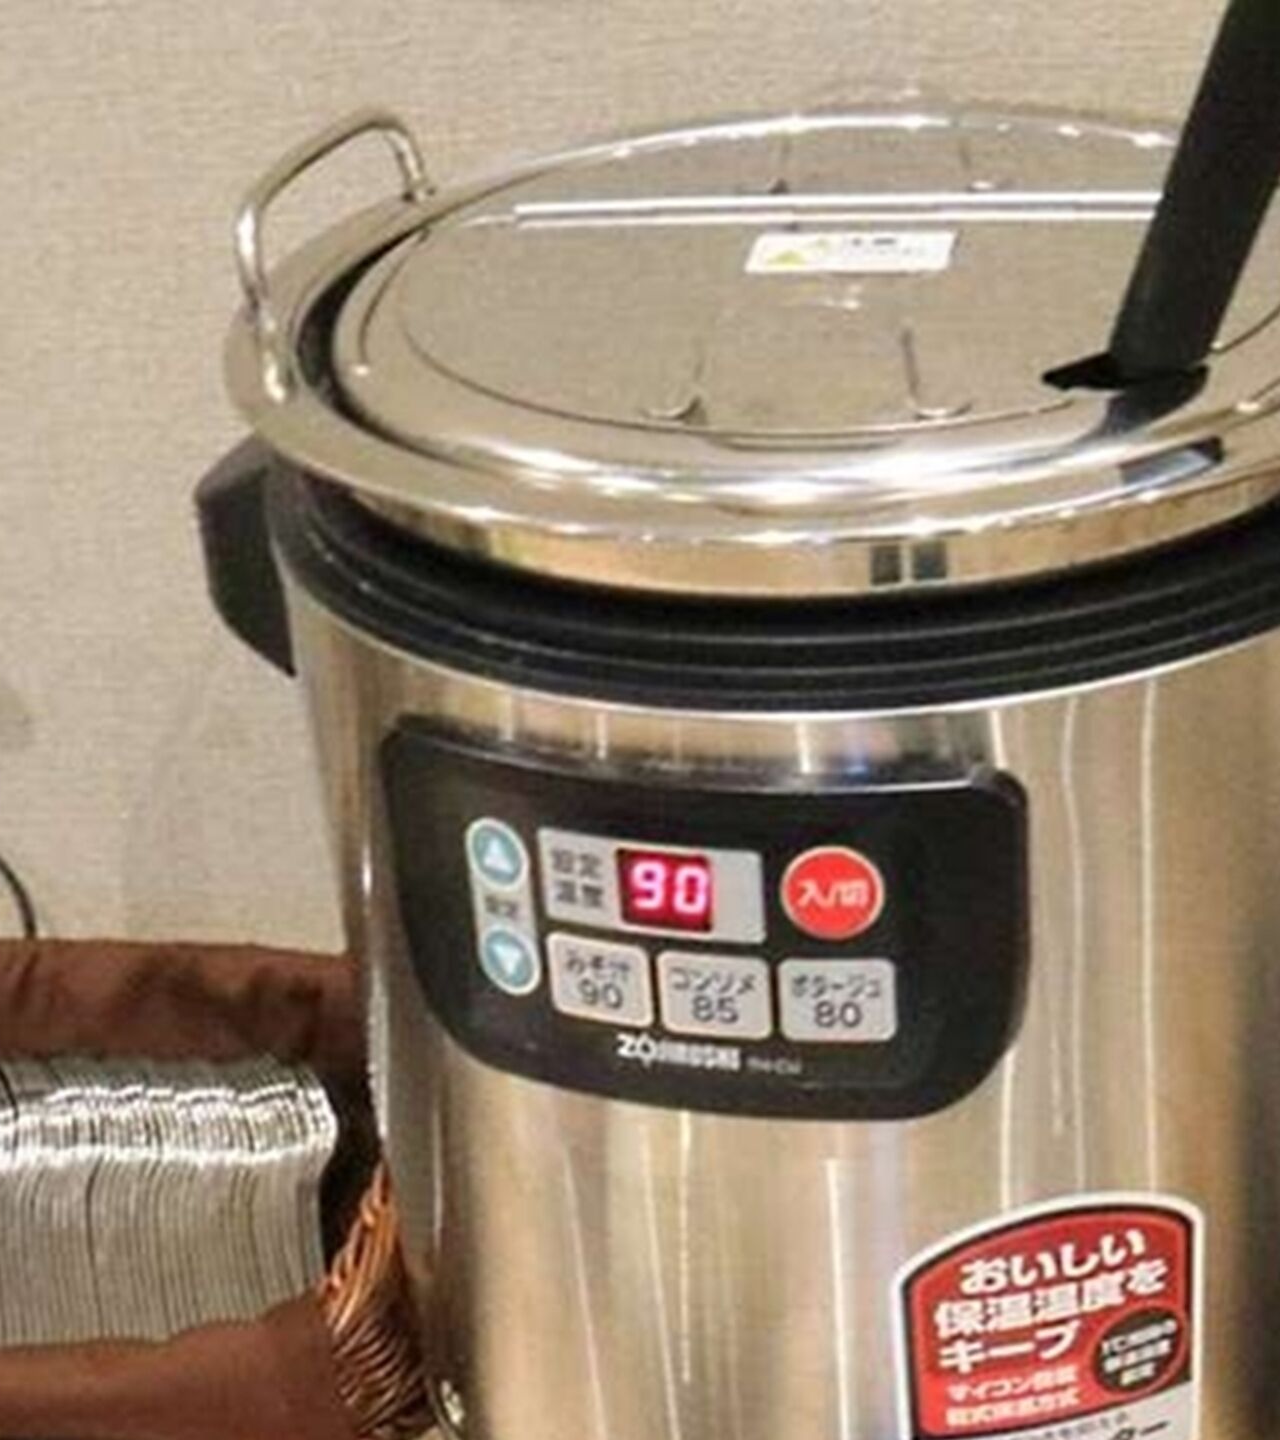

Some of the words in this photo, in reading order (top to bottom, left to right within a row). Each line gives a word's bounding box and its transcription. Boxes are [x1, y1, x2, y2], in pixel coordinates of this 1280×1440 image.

[631, 859, 710, 914] 90
[578, 978, 624, 1010] 90
[692, 995, 739, 1024] 85
[814, 1000, 862, 1028] 80
[960, 1228, 1147, 1295] おいしい
[934, 1258, 1168, 1340] 保温温度を
